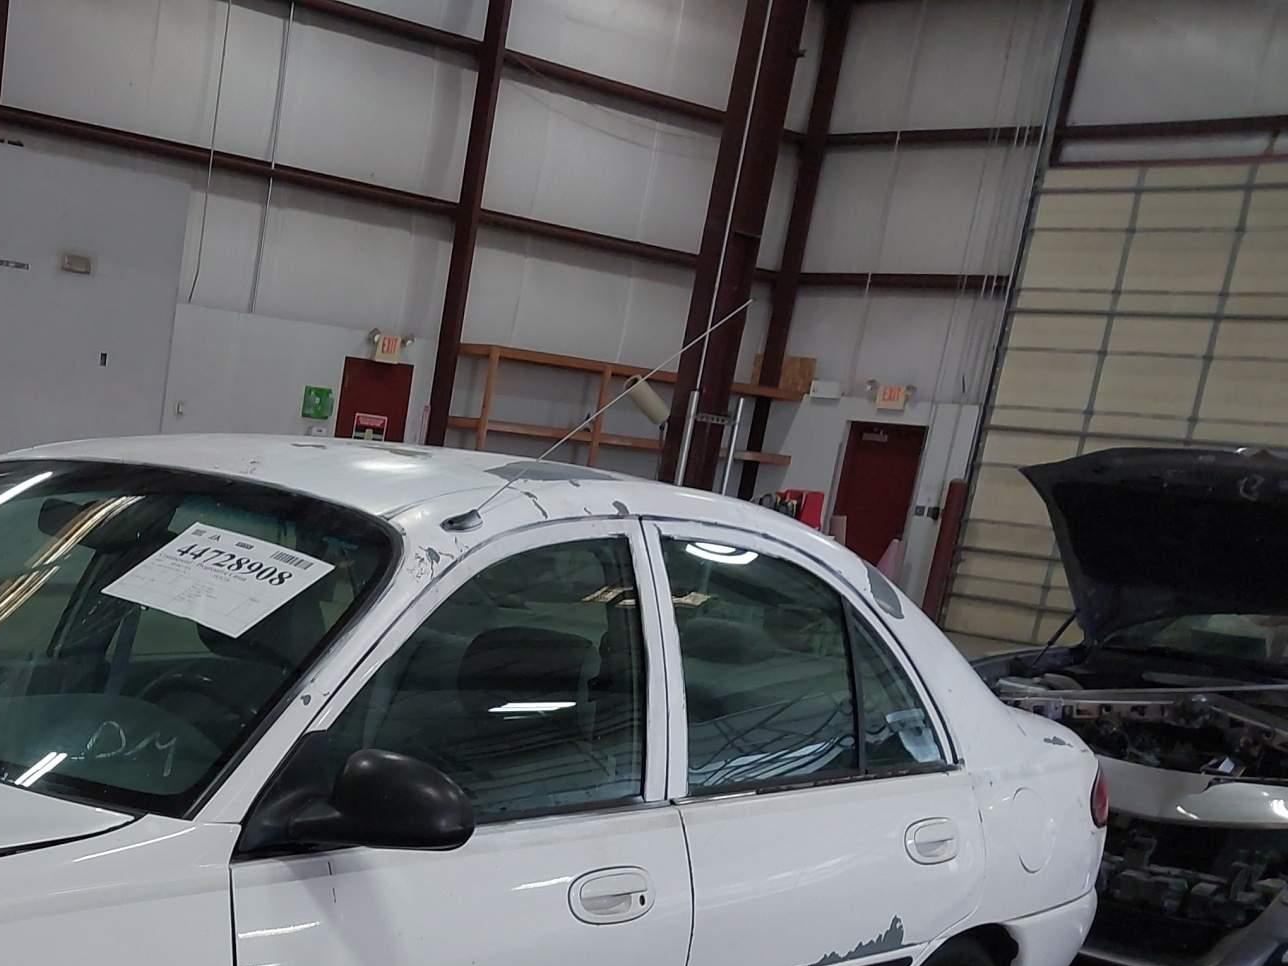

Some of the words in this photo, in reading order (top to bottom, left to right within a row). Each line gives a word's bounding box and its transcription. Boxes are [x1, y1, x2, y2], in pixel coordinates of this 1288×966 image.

[382, 335, 397, 353] EXIT
[882, 387, 901, 401] EXIT
[177, 543, 293, 586] 44728908
